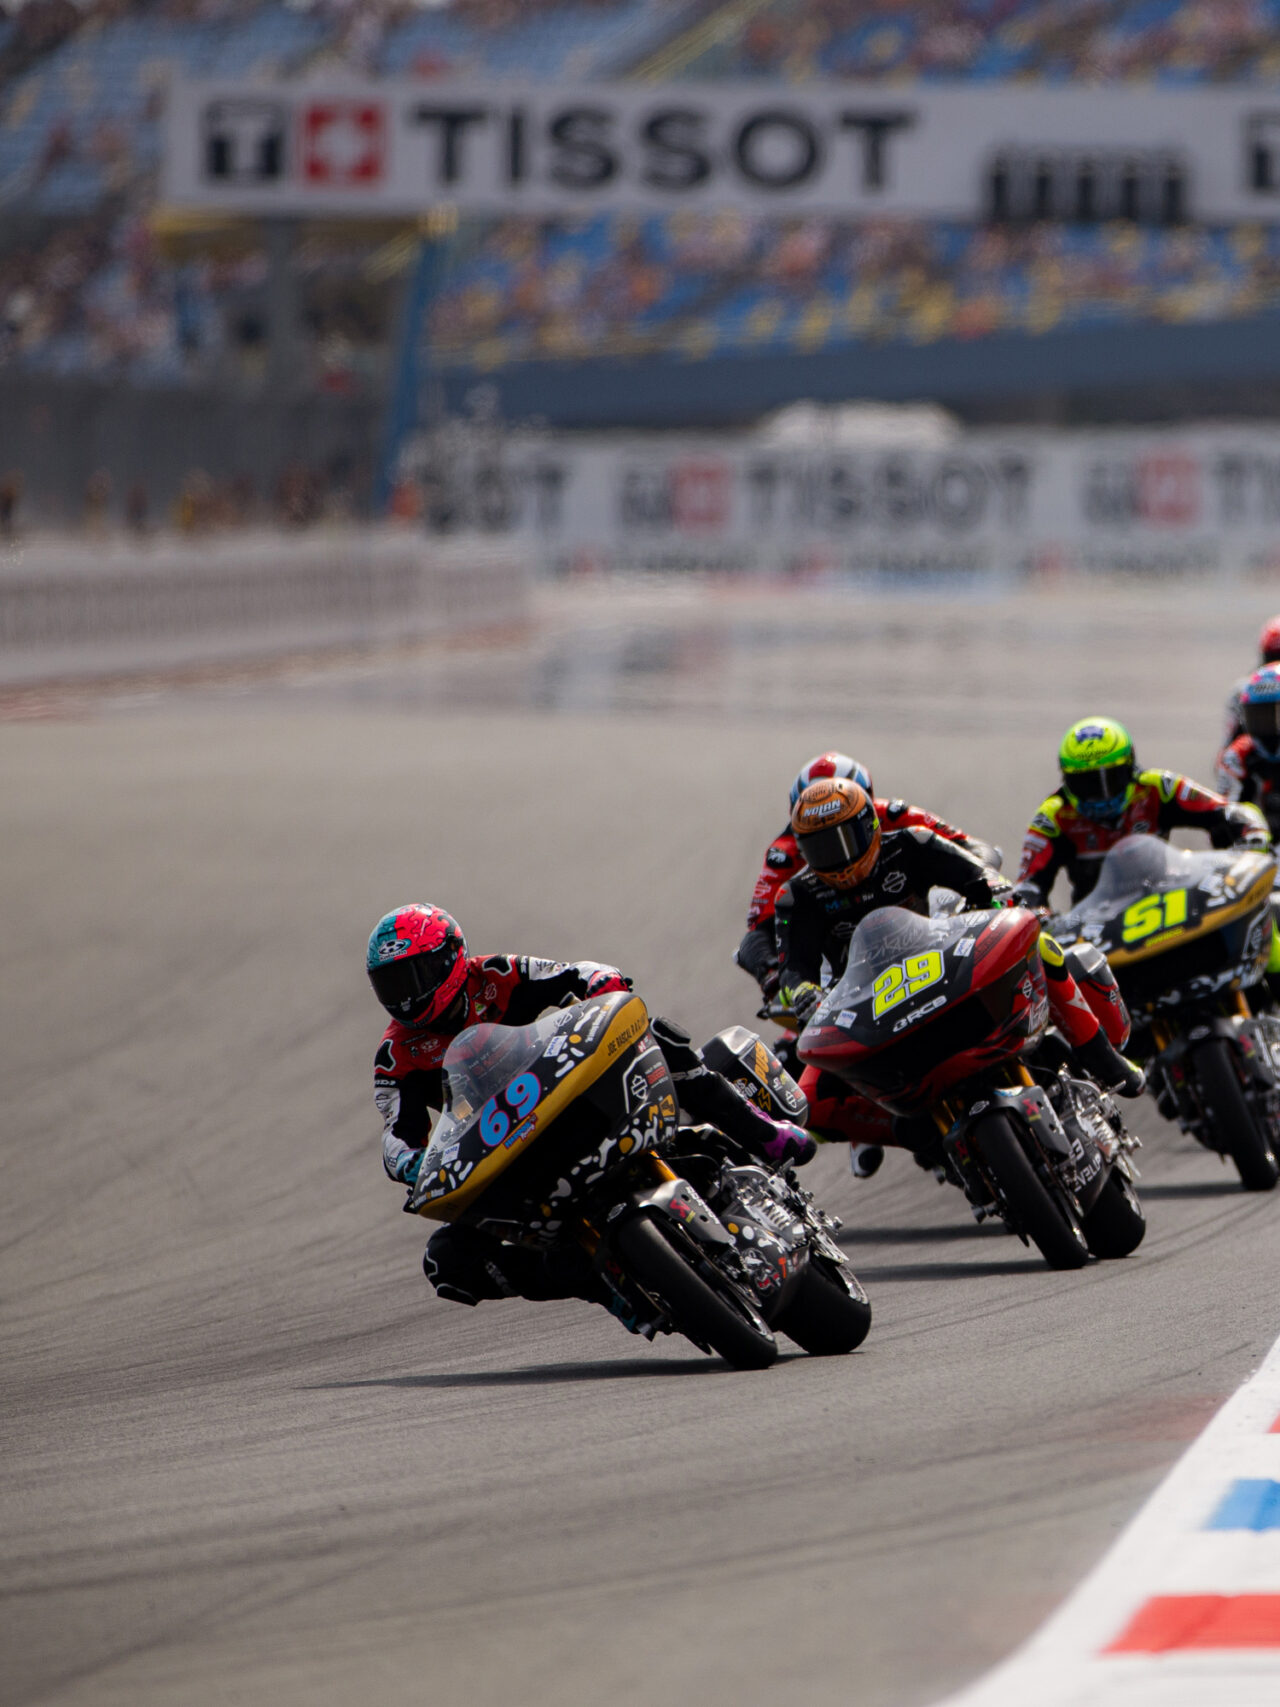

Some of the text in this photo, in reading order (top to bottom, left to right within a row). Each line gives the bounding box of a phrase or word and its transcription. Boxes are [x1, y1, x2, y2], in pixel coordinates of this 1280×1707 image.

[411, 104, 912, 190] TISSOT
[746, 453, 1036, 532] TISSOT
[803, 799, 841, 818] NOLAN
[1122, 887, 1189, 944] 51
[872, 949, 946, 1020] 29
[479, 1071, 542, 1147] 69
